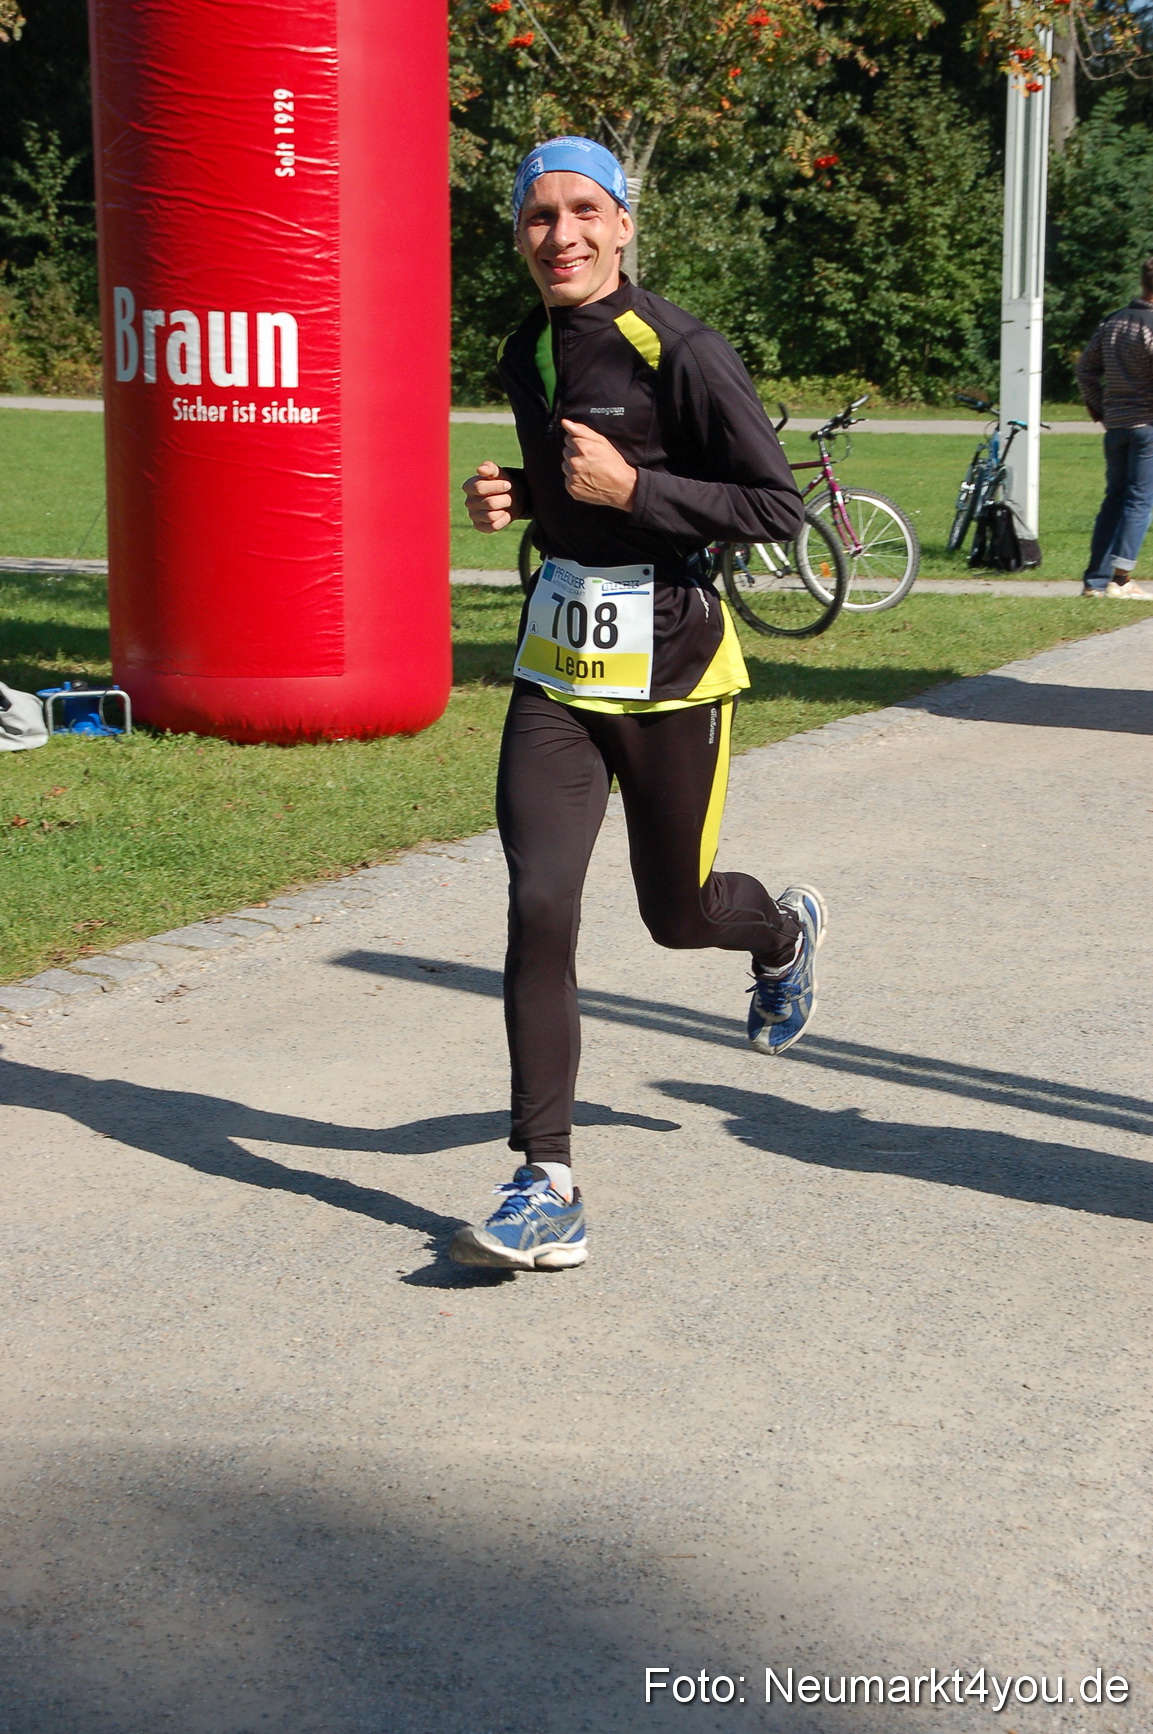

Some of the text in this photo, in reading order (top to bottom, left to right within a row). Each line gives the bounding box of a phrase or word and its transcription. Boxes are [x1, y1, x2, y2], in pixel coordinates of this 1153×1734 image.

[273, 88, 296, 135] 1929
[113, 286, 300, 389] Braun
[173, 397, 321, 424] Sicher ist sicher
[551, 592, 618, 649] 708
[555, 646, 605, 679] Leon
